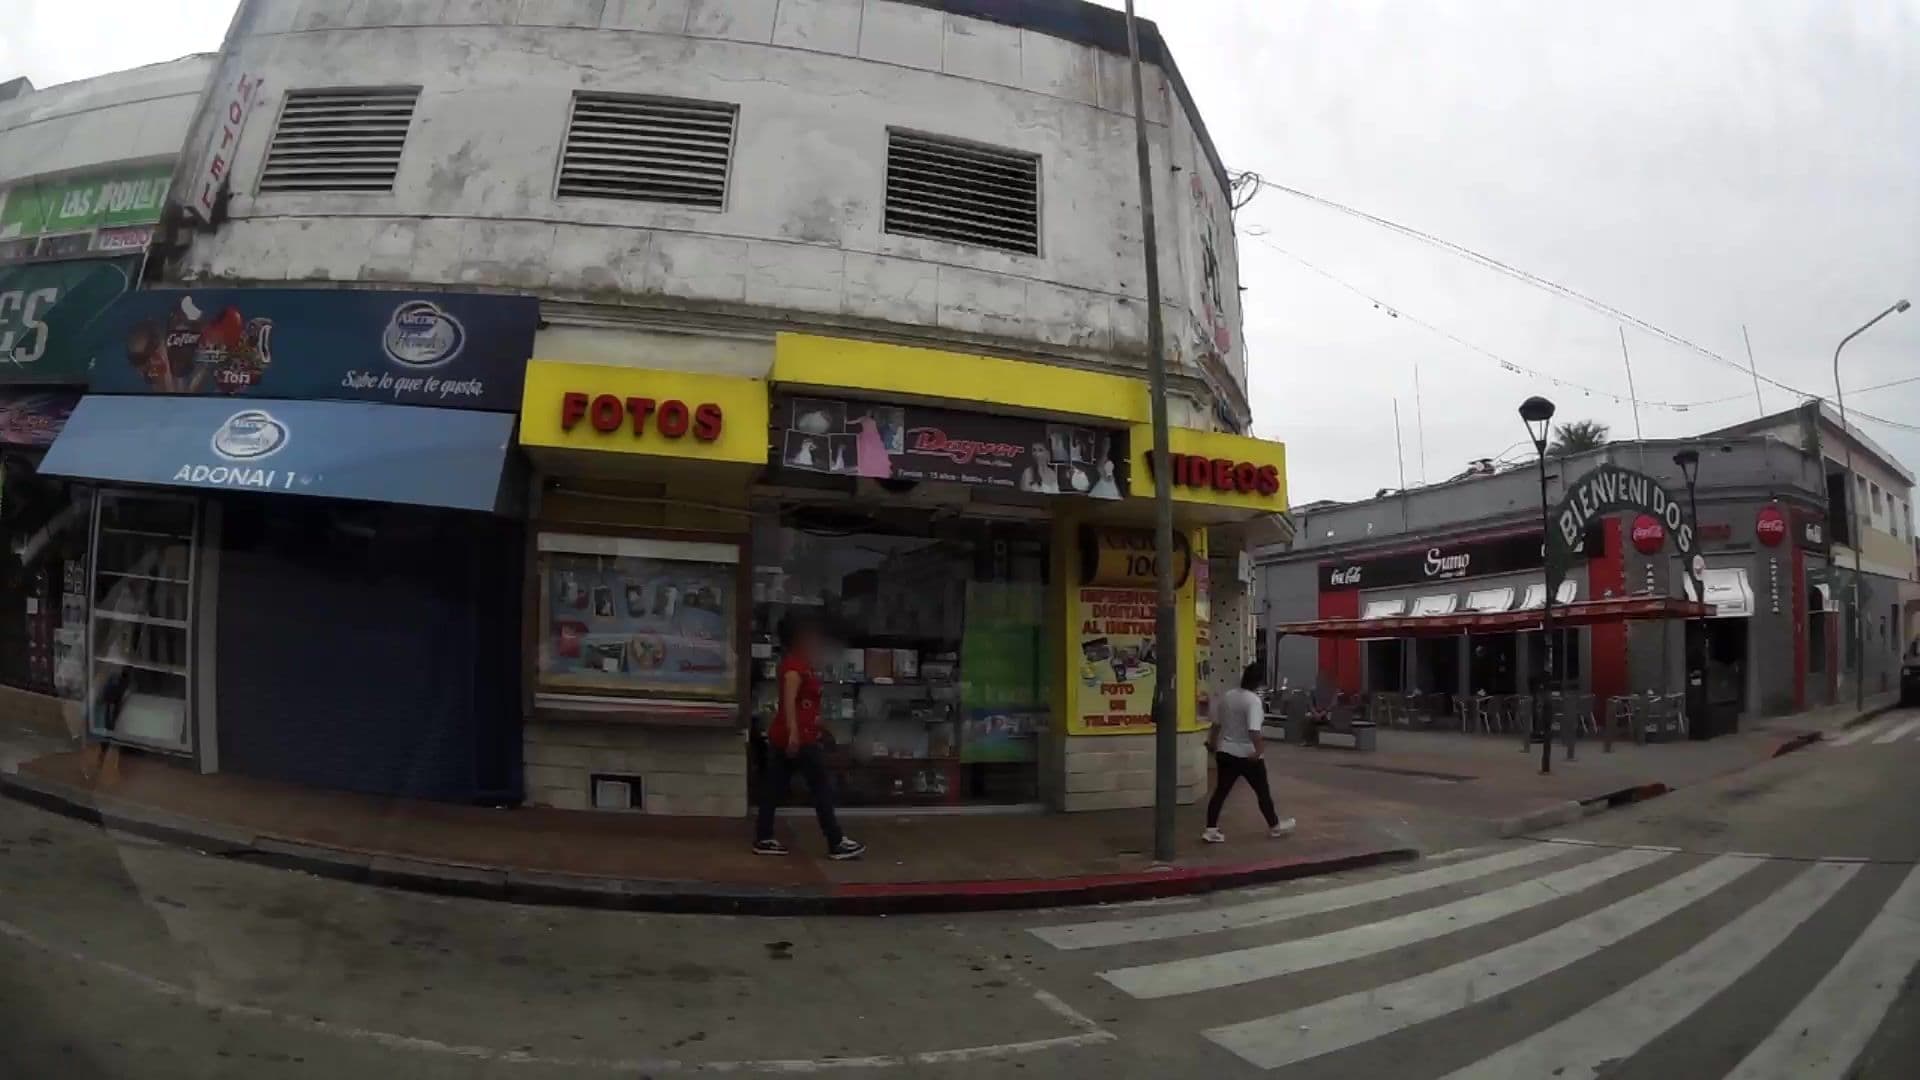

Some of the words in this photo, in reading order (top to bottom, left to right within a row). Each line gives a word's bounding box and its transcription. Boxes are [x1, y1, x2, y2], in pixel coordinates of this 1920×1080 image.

[341, 370, 379, 389] Sabe
[378, 371, 393, 389] lo
[394, 377, 423, 398] que
[424, 376, 440, 393] te
[561, 392, 722, 442] FOTOS
[173, 464, 276, 488] ADONAI
[1560, 472, 1692, 552] BIENVENIDOS
[1101, 683, 1135, 695] FOTO
